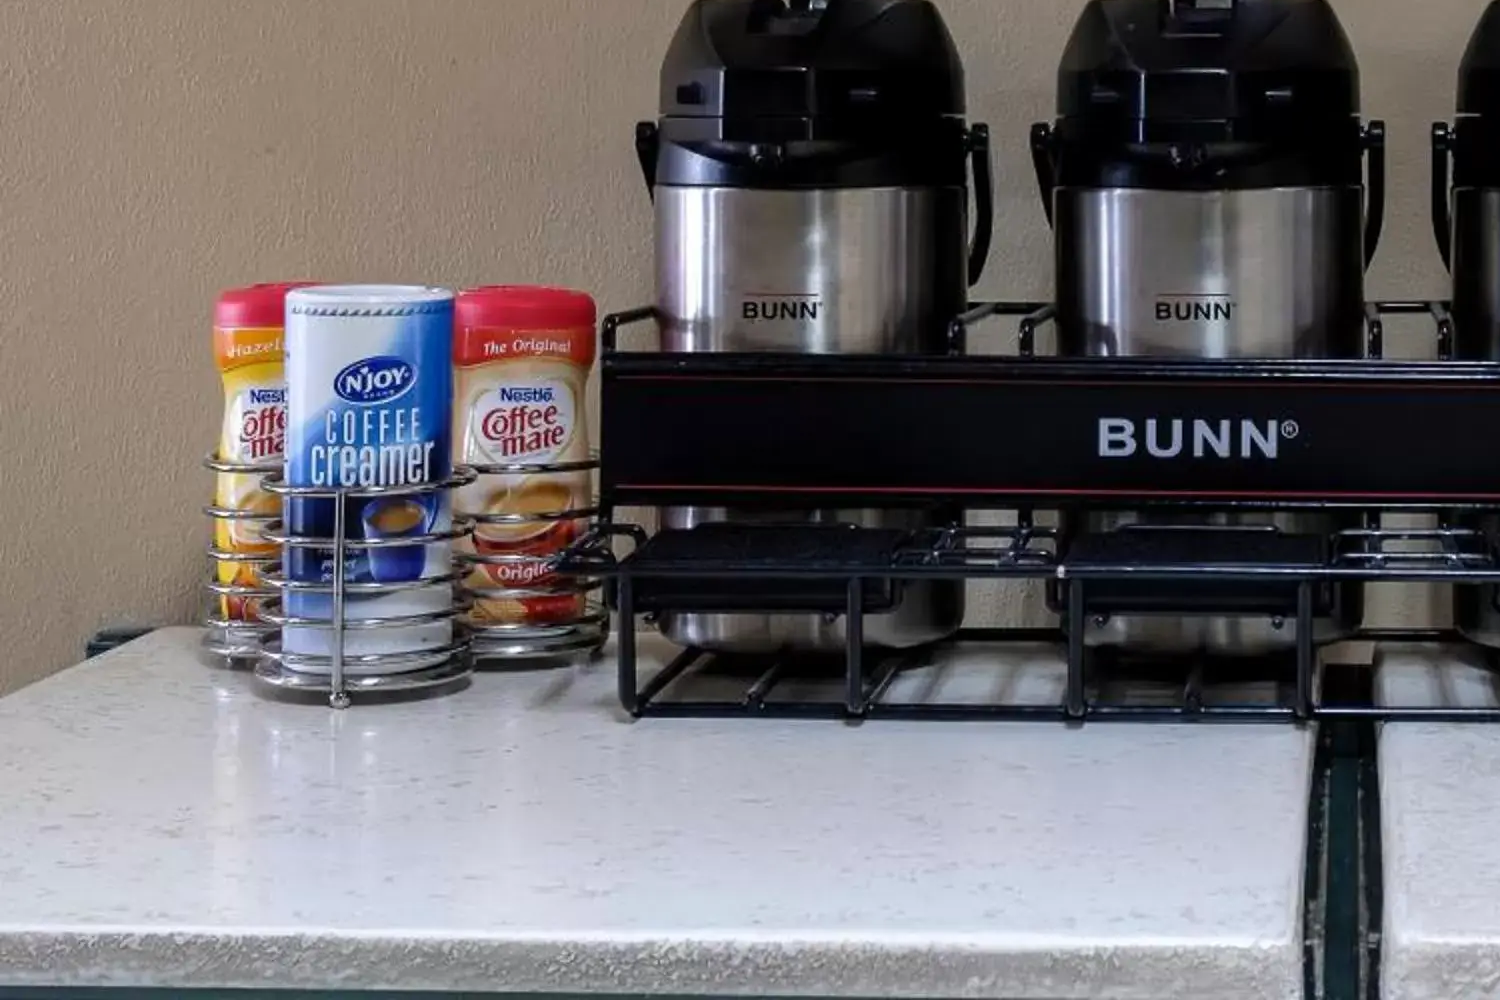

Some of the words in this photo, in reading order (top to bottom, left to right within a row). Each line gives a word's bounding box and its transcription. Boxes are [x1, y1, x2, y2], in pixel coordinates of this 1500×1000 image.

[742, 301, 817, 319] BUNN
[1155, 301, 1231, 320] BUNN
[225, 337, 282, 358] Hazel
[484, 339, 507, 355] The
[512, 338, 571, 355] Original
[325, 407, 420, 444] COFFEE
[481, 405, 558, 441] Coffee
[501, 425, 565, 456] mate
[311, 440, 435, 486] creamer
